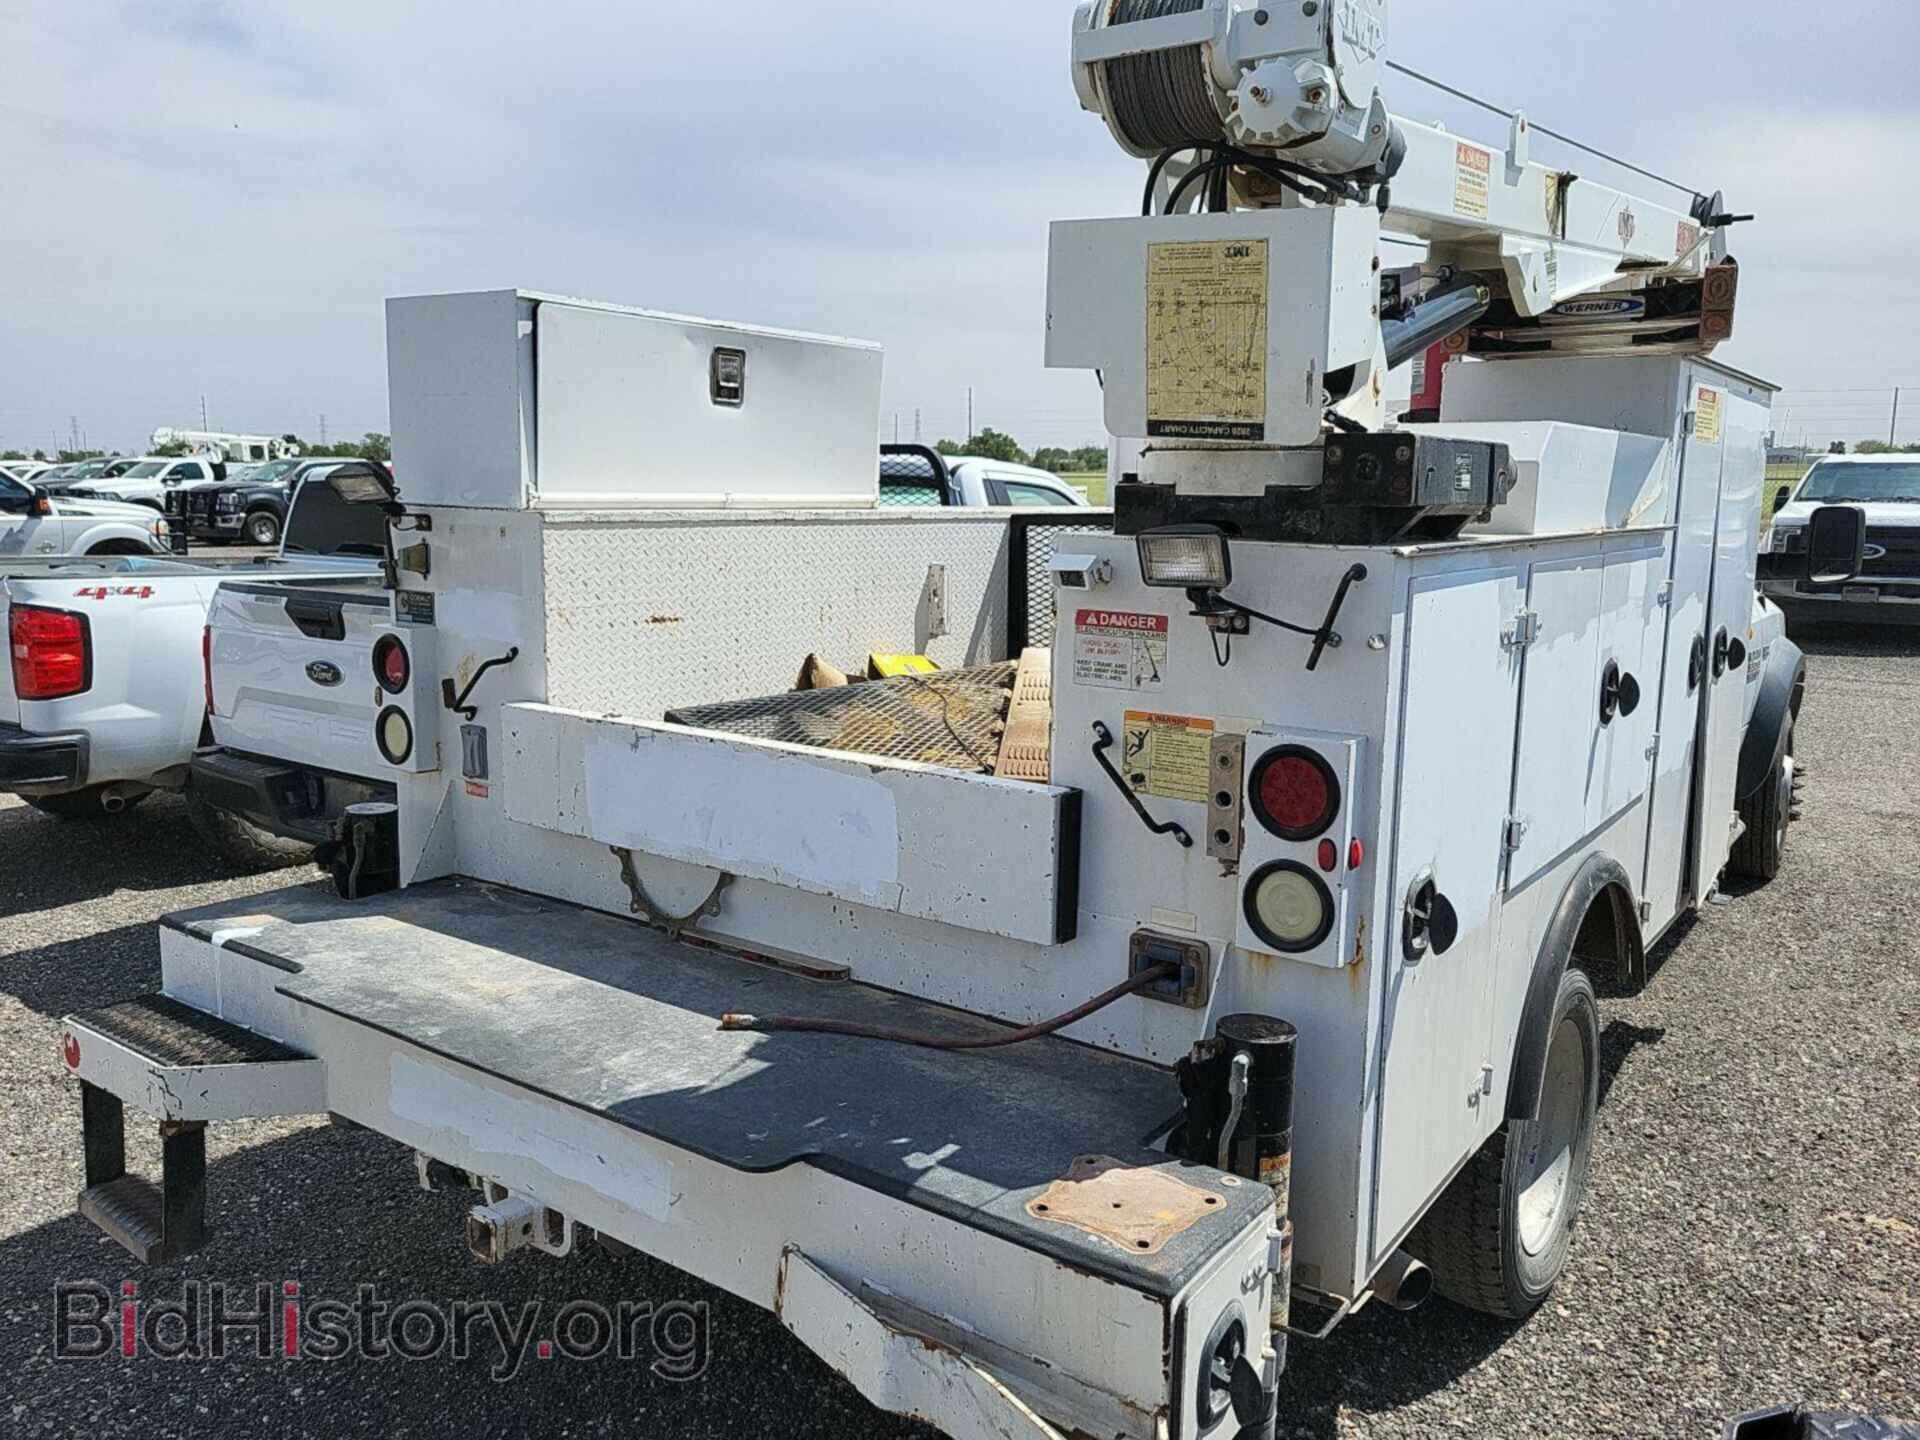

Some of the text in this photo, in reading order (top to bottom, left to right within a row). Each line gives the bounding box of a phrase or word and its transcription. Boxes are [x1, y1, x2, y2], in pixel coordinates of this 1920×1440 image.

[1223, 246, 1250, 258] IMT
[1565, 302, 1622, 313] WERNER
[1160, 424, 1187, 435] CHART
[1188, 424, 1230, 436] CAPACITY
[1099, 613, 1157, 629] DANGER
